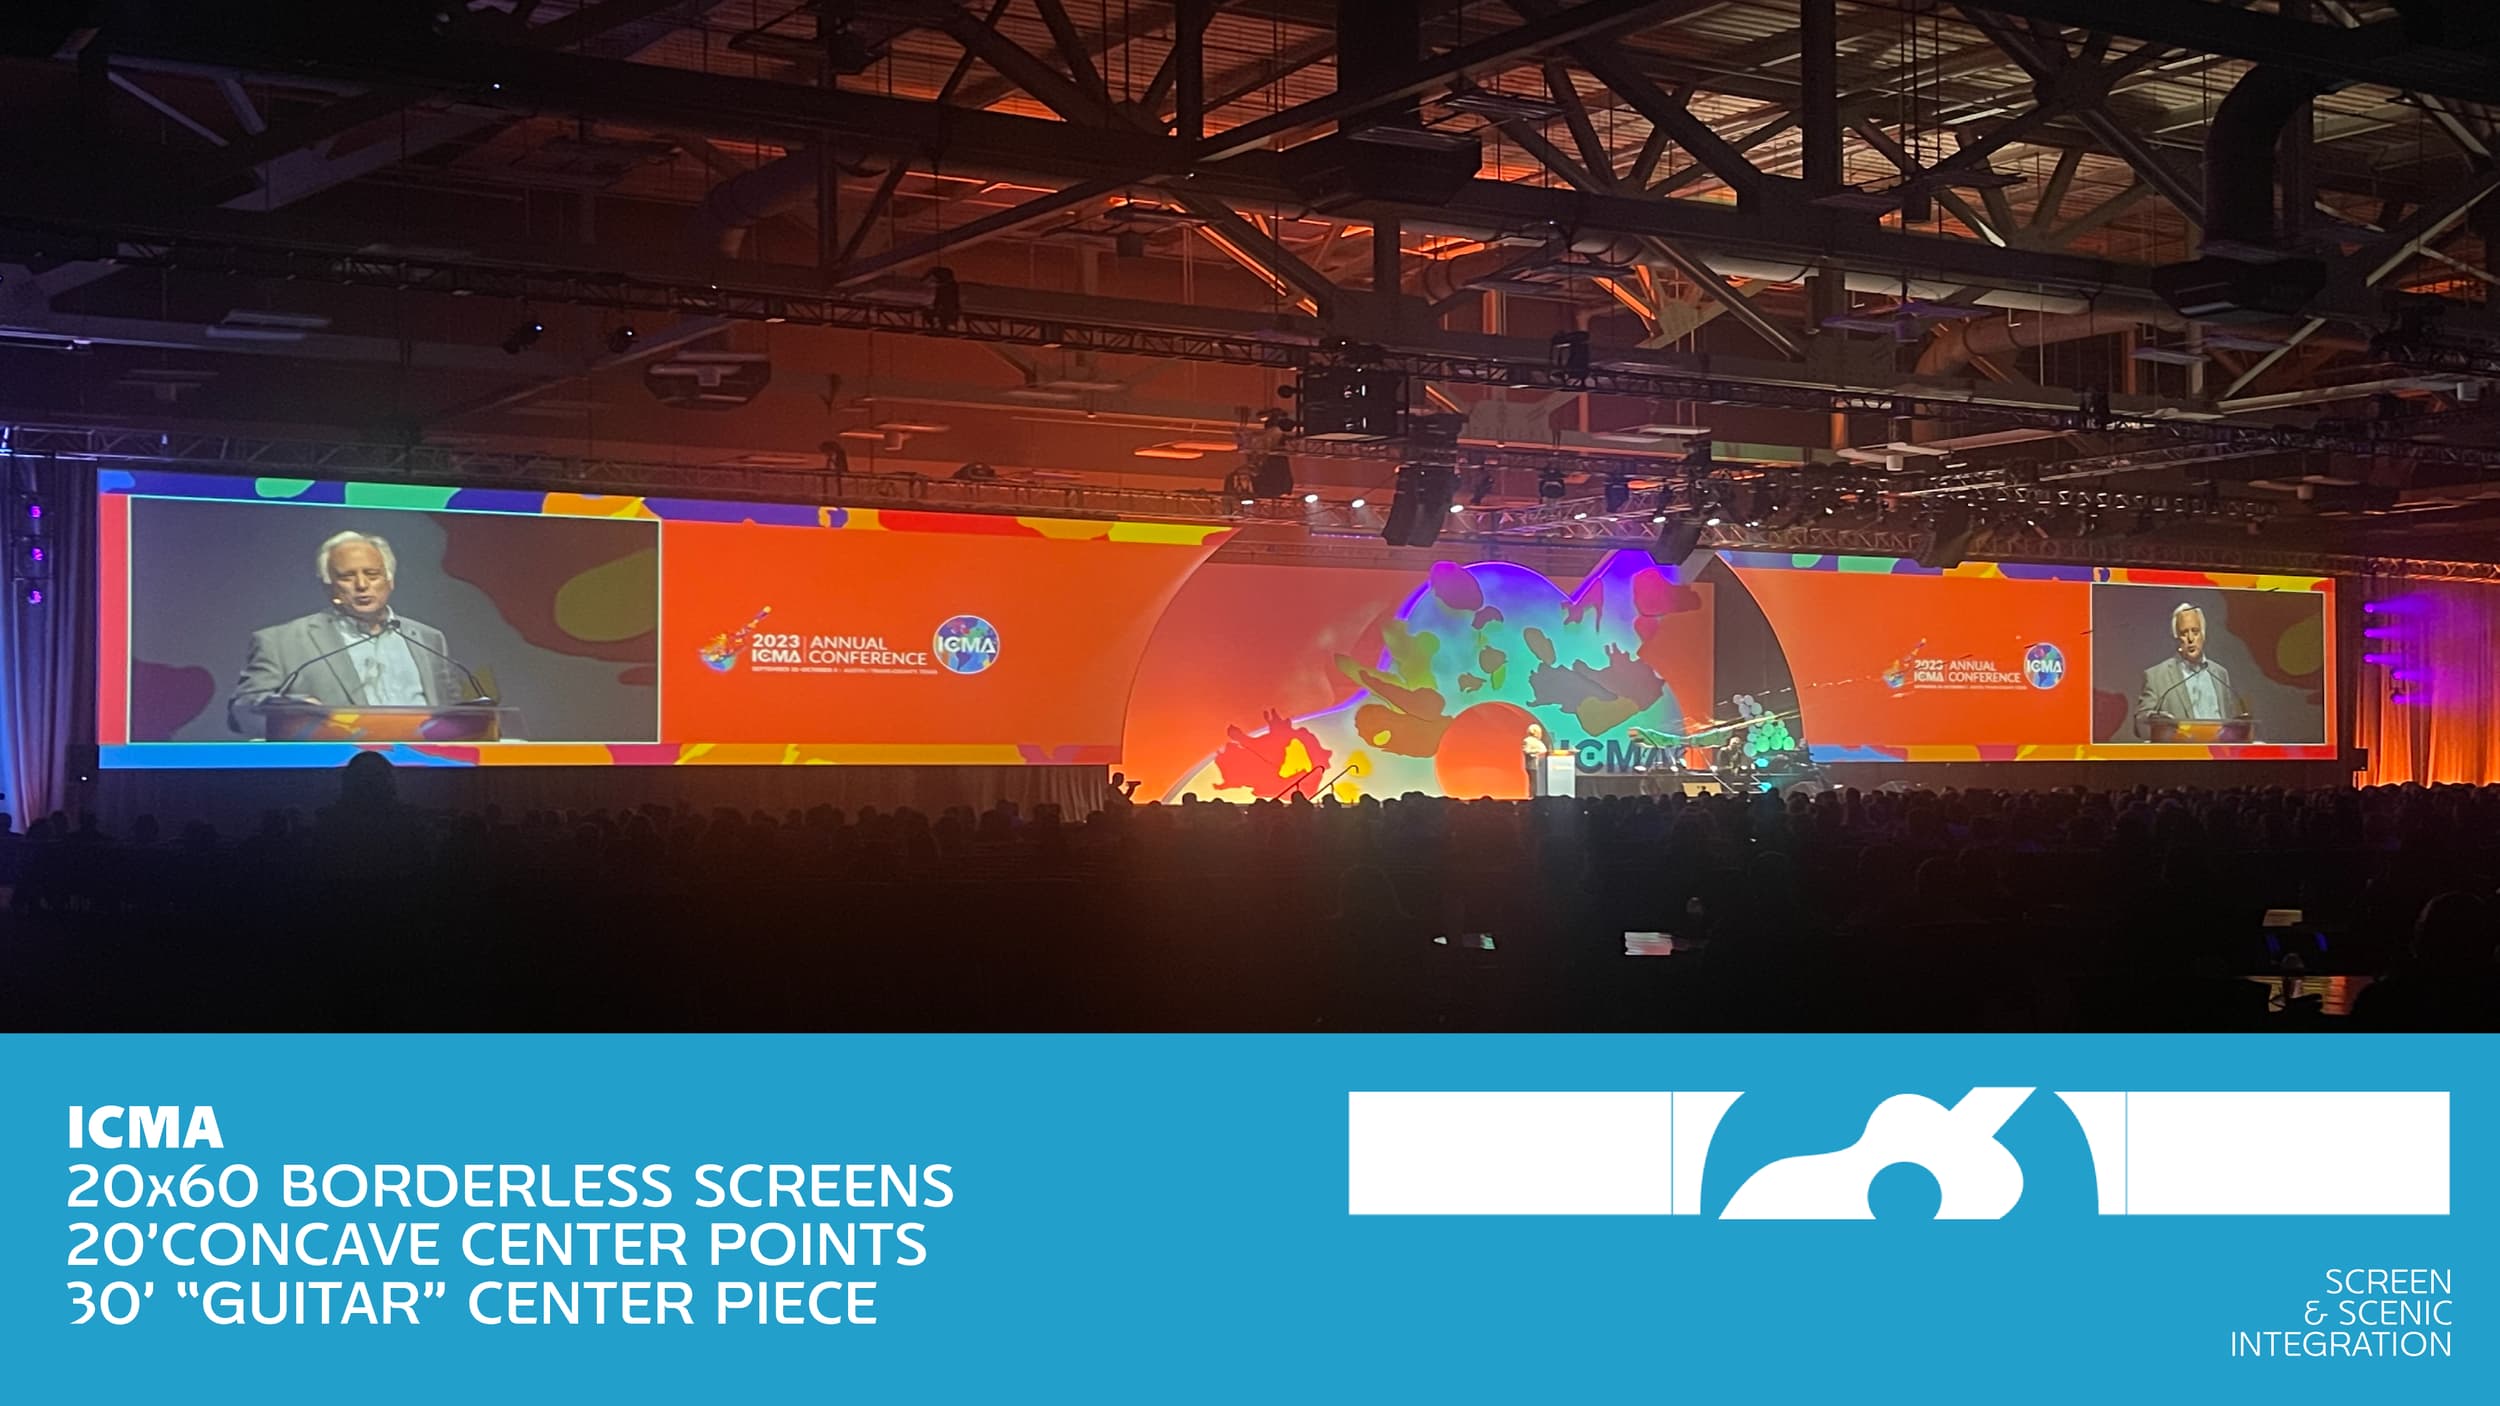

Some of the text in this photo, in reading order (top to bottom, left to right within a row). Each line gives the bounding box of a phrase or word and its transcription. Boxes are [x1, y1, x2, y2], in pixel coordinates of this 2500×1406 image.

[752, 634, 888, 651] 2023 ANNUAL
[937, 635, 997, 655] ICMA
[752, 649, 928, 666] ICMA CONFERENCE
[1949, 660, 1997, 672] ANNUAL
[2026, 659, 2063, 673] ICMA
[1913, 671, 2022, 684] ICMA CONFERENCE
